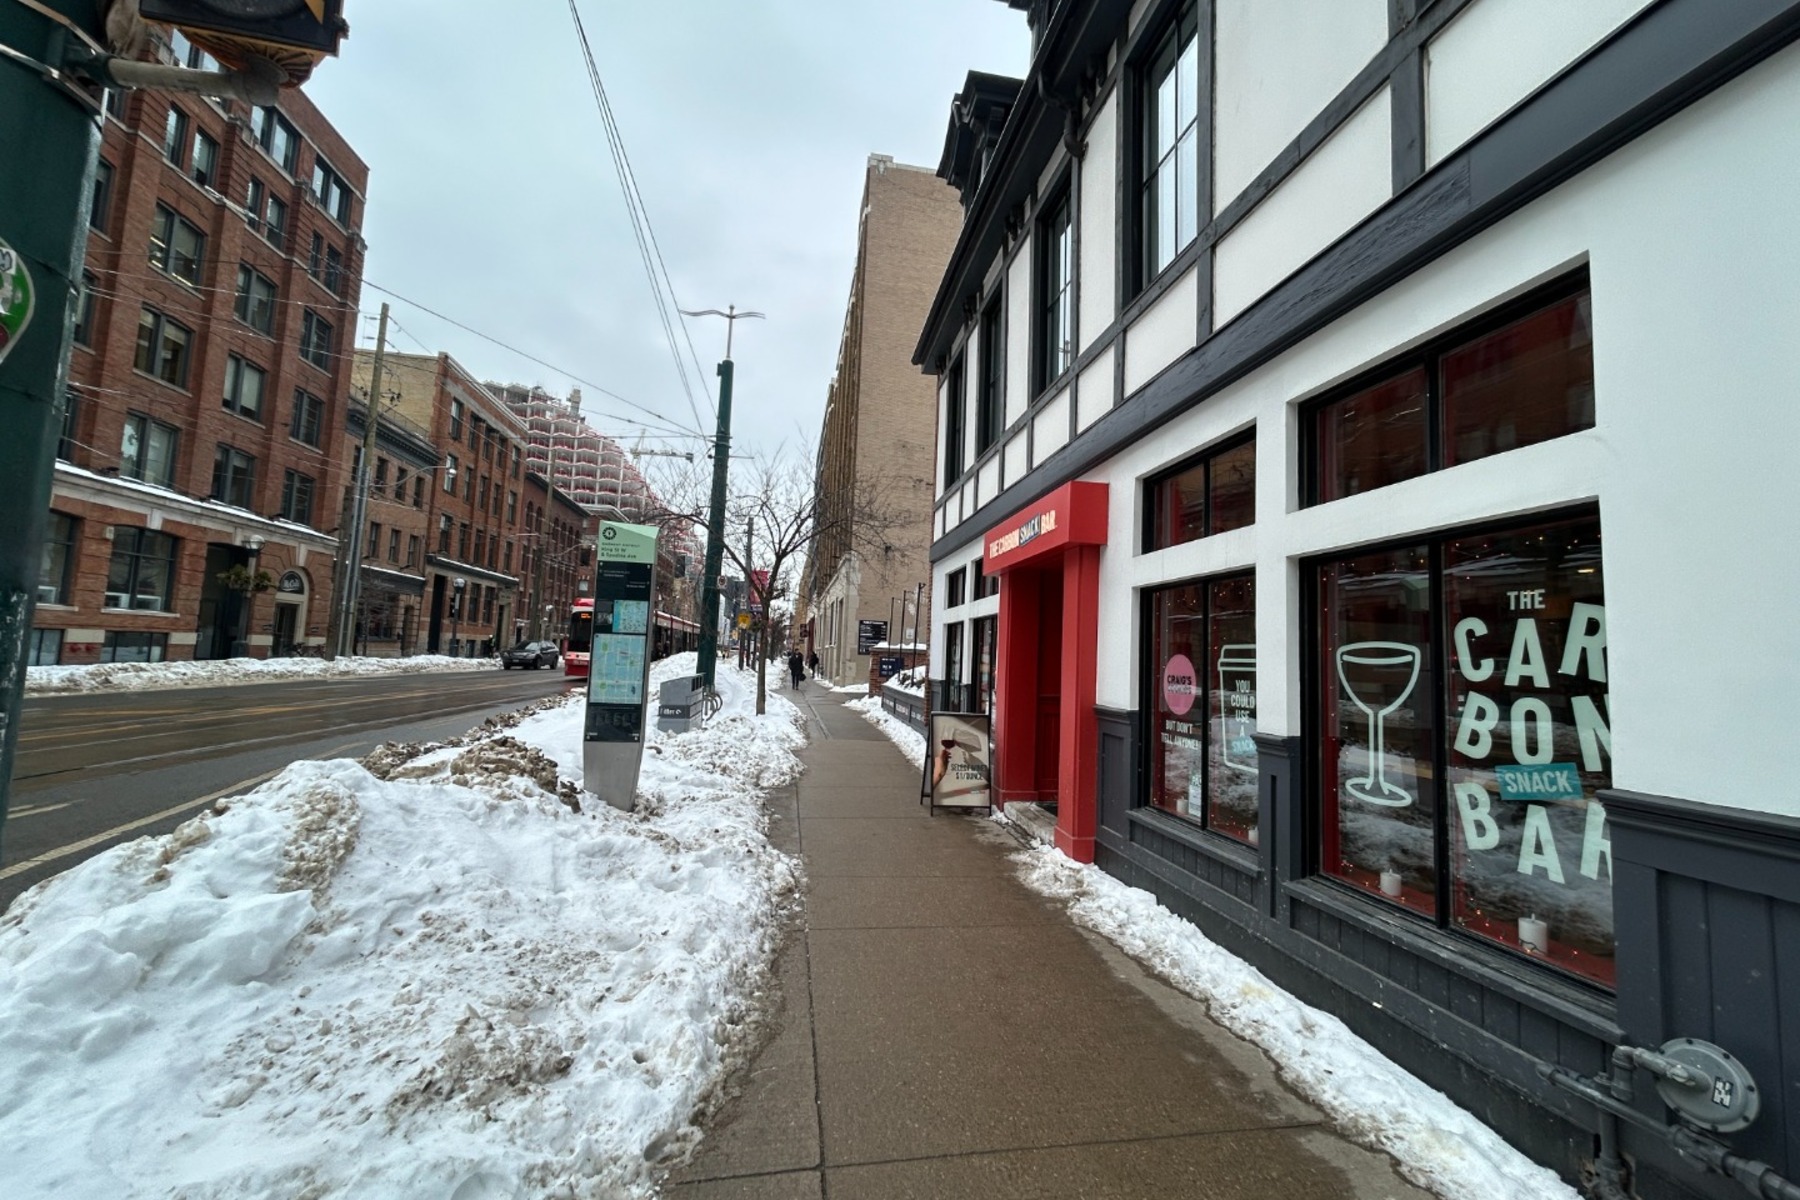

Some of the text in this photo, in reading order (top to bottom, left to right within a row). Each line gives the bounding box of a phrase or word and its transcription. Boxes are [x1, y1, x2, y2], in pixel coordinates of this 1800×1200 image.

[989, 510, 1056, 559] THE CARBON SNACK BAR
[1507, 589, 1546, 611] THE
[1453, 601, 1608, 689] CAR
[1167, 674, 1192, 685] CRAIG'S
[1235, 680, 1251, 693] YOU
[1230, 694, 1255, 709] COULD
[1235, 710, 1250, 724] USE
[1166, 720, 1193, 734] BUT DON'T
[1504, 770, 1573, 793] SNACK
